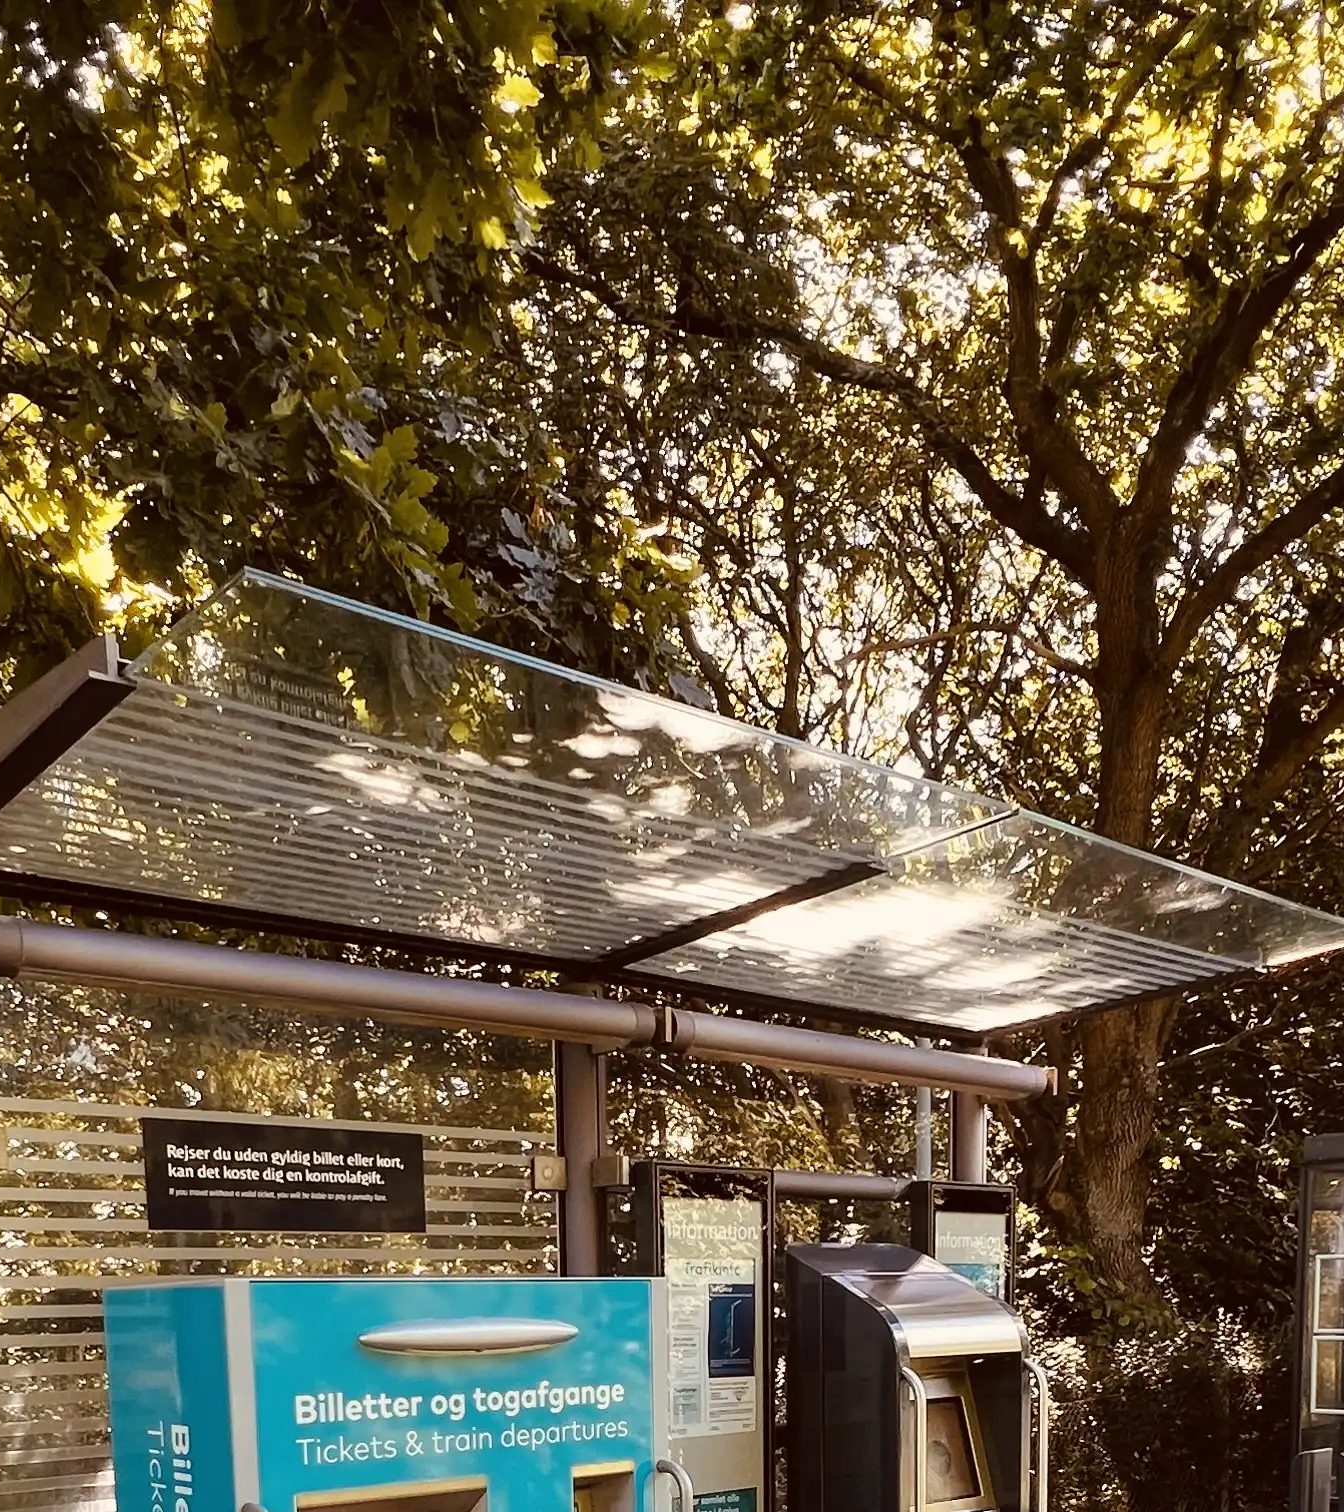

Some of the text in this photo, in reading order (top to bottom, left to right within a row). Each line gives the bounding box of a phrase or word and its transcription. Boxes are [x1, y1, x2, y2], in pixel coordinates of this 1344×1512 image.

[166, 1144, 404, 1170] Rejser du uden gyldig billet eller kort,
[167, 1163, 385, 1186] kan det koste dig en kontrolafgift.
[668, 1219, 757, 1241] Information
[295, 1380, 625, 1425] Billetter og togafgange
[296, 1419, 628, 1465] Tickets & train departures
